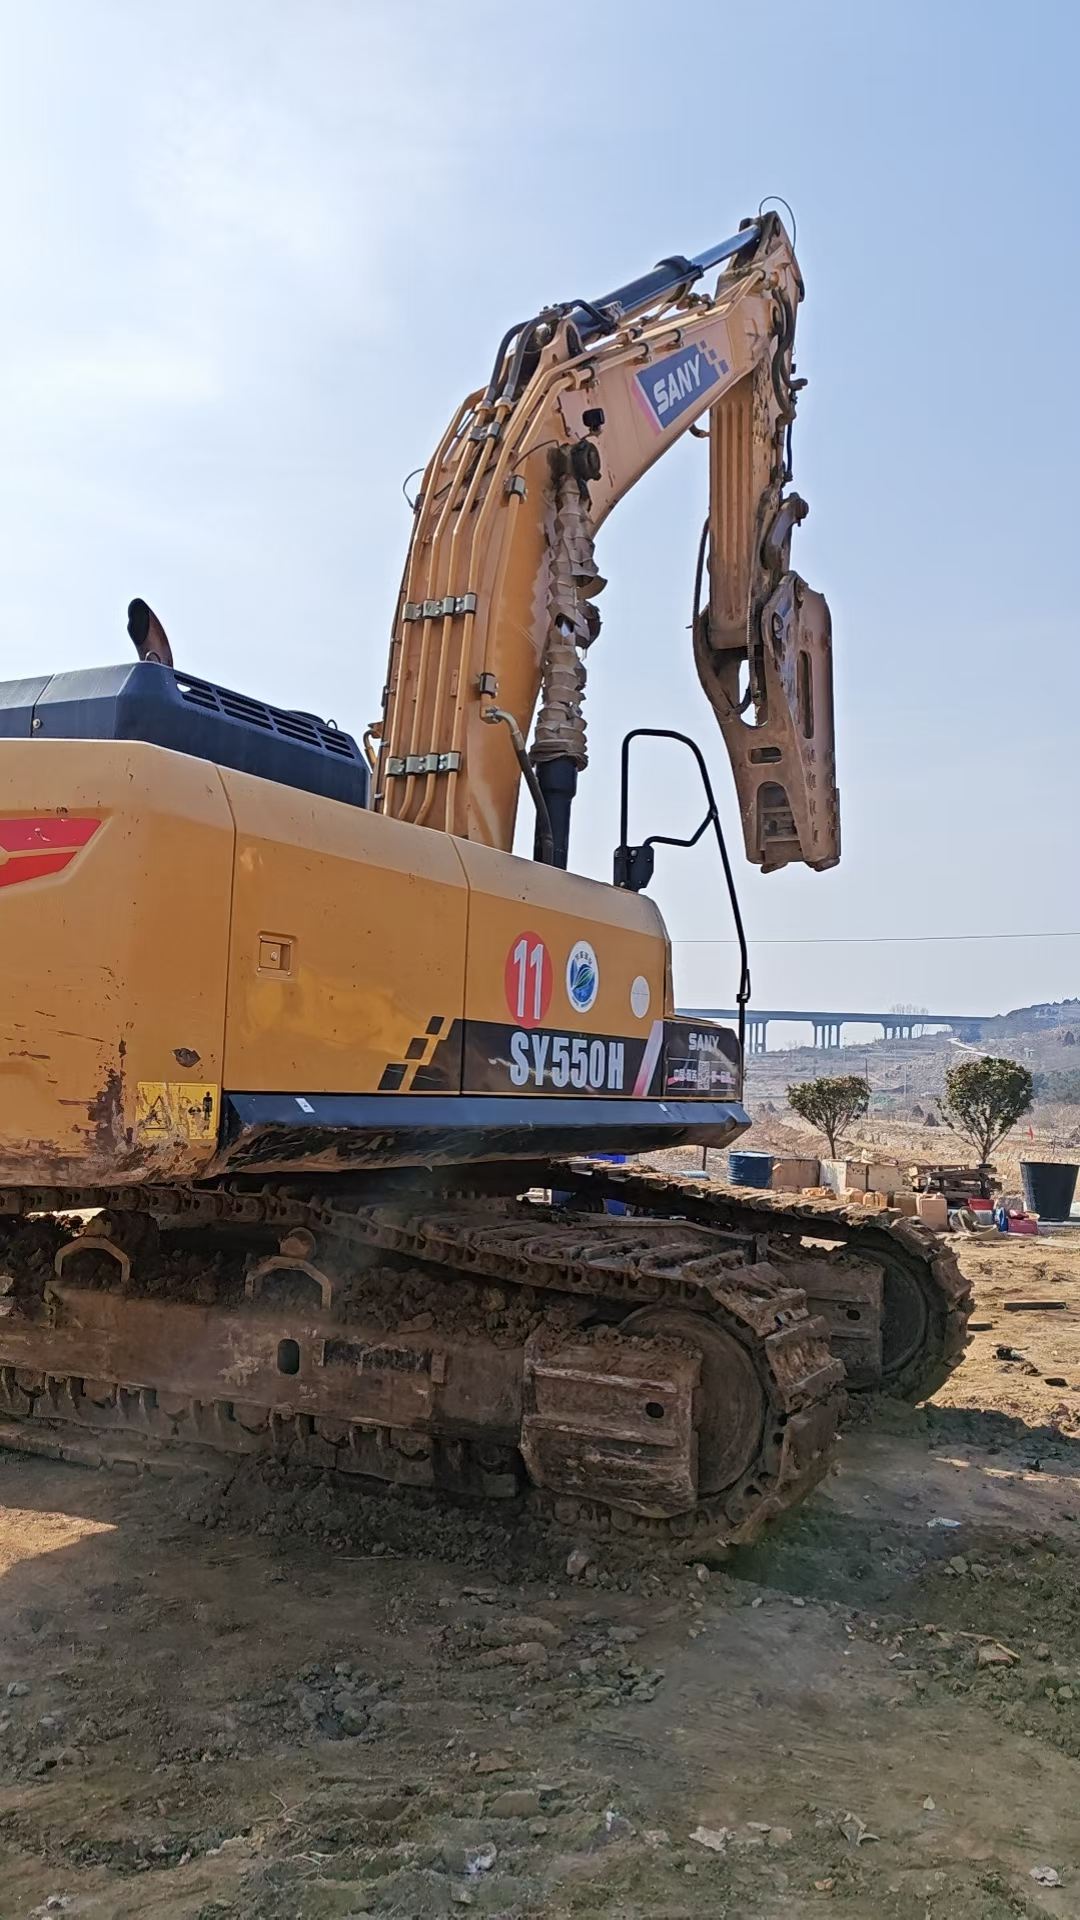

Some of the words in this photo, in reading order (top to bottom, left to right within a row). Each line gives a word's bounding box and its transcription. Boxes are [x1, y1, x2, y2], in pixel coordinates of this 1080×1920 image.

[654, 354, 700, 415] SANY
[513, 939, 544, 1020] 11
[510, 1031, 624, 1090] SY550H
[688, 1032, 720, 1052] SANY
